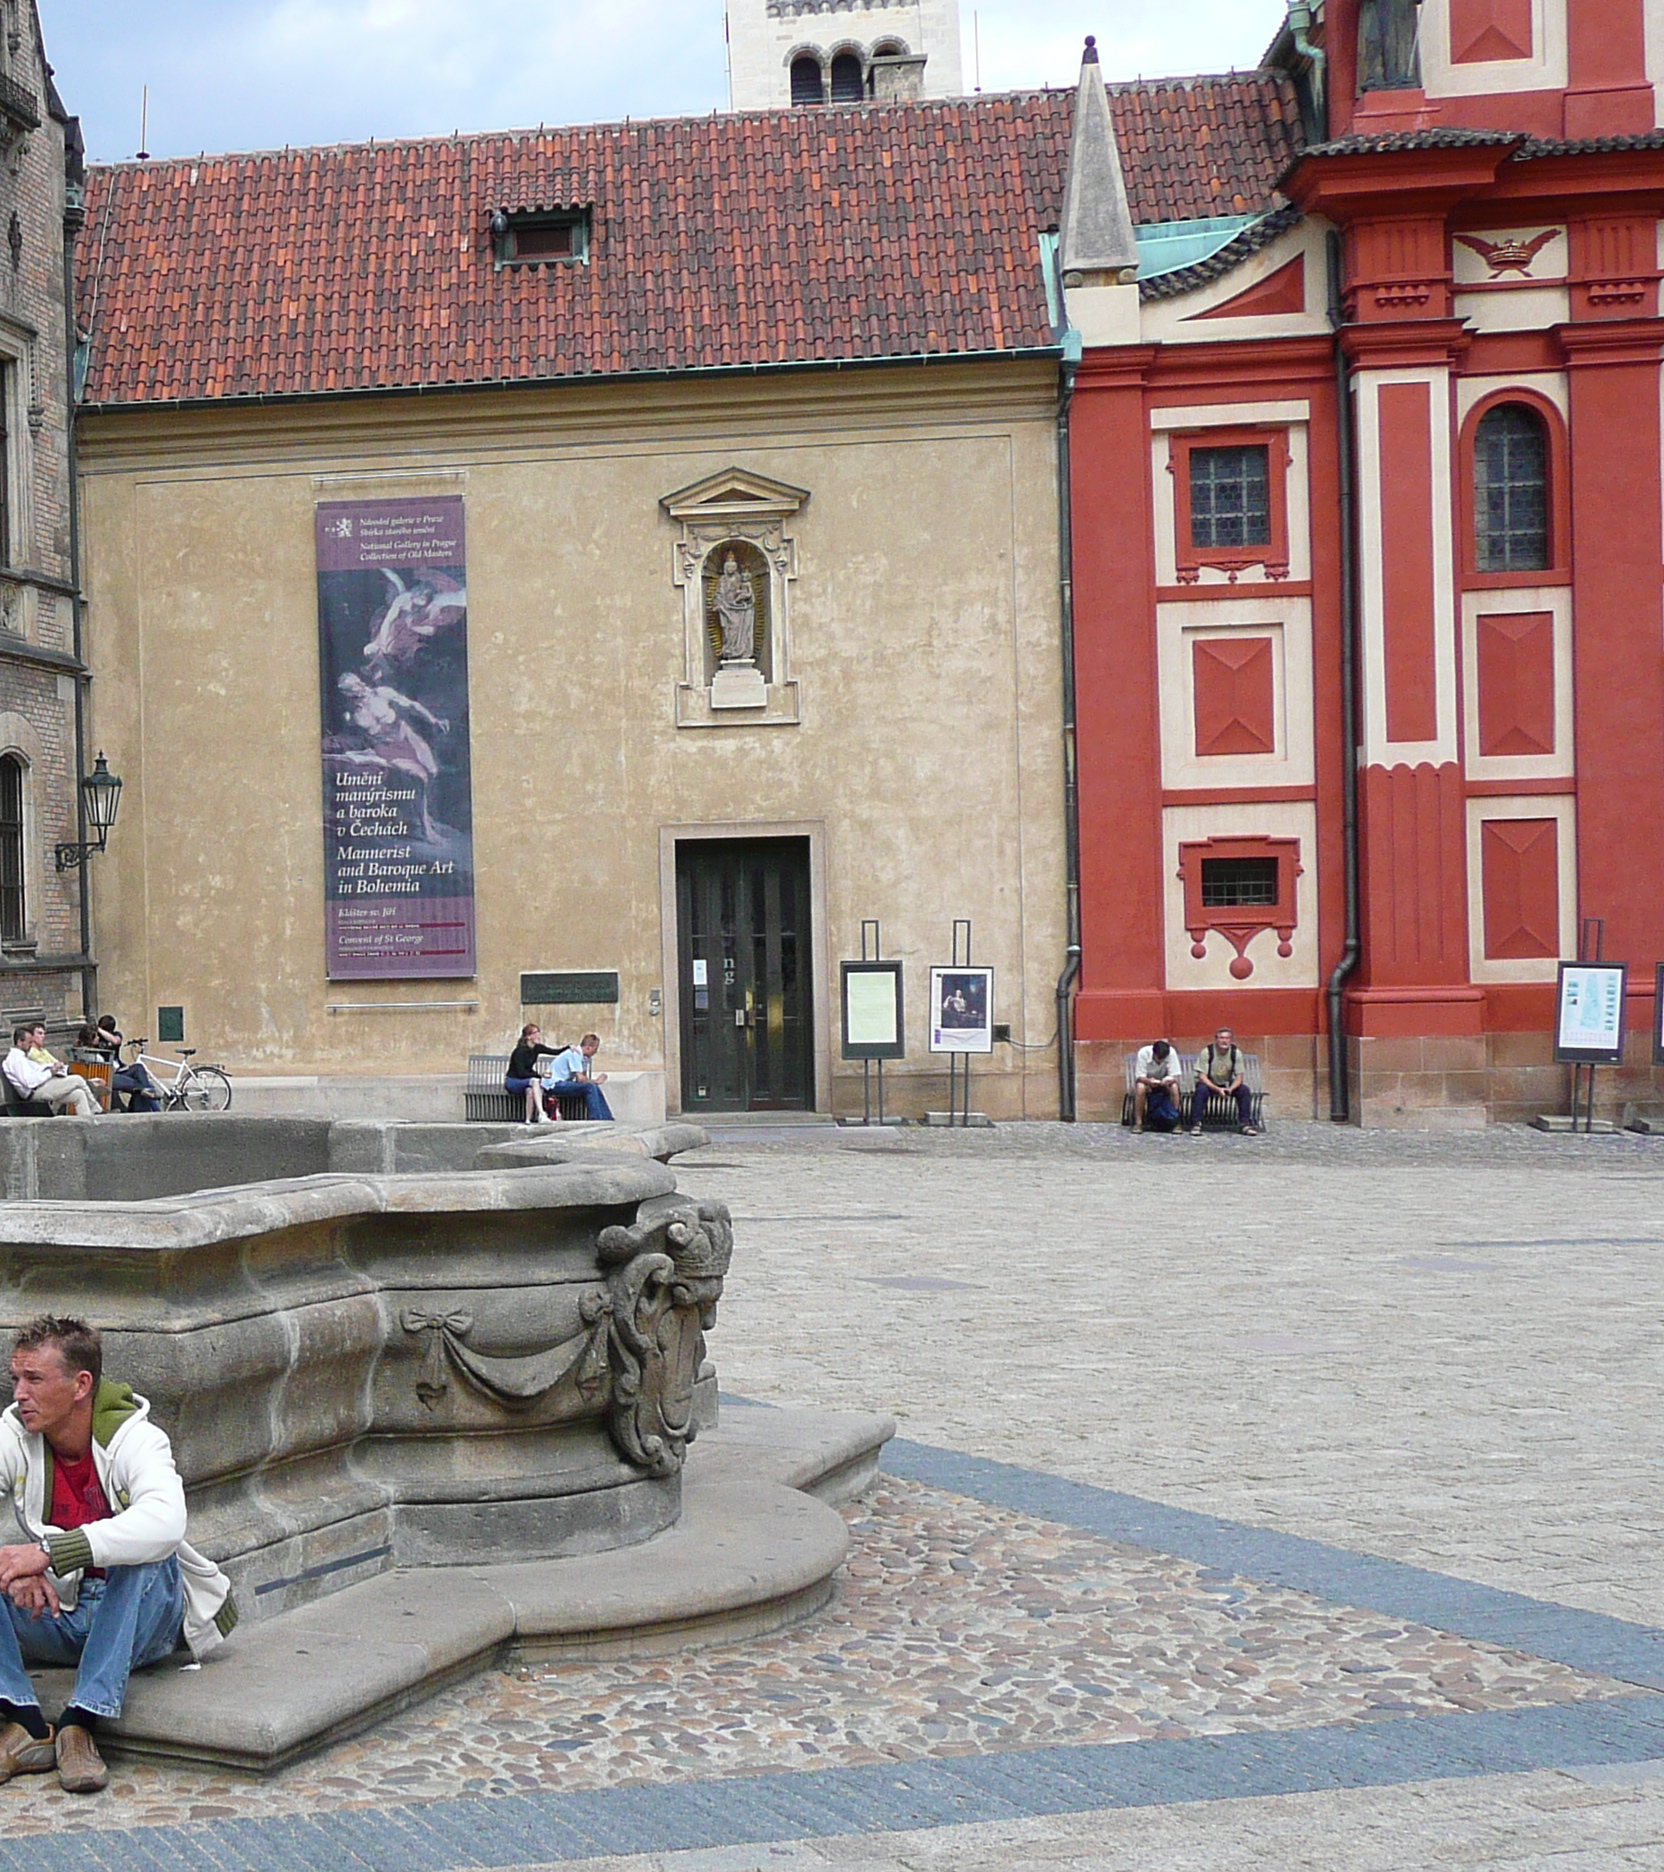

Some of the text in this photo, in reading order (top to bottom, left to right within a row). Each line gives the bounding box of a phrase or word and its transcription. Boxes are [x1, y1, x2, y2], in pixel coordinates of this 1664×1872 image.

[360, 541, 393, 550] National
[394, 540, 421, 550] Gallery
[431, 539, 457, 549] Prague
[360, 551, 397, 561] Collection
[408, 550, 422, 559] Old
[423, 549, 453, 558] Masters
[336, 771, 384, 786] Umění
[336, 786, 416, 806] manýrismu
[336, 803, 398, 819] a baroka
[337, 819, 408, 837] v Čechách
[337, 845, 413, 861] Mannerist
[338, 860, 456, 880] and Baroque Art
[338, 878, 421, 894] in Bohemia
[338, 934, 424, 945] Convent of St George
